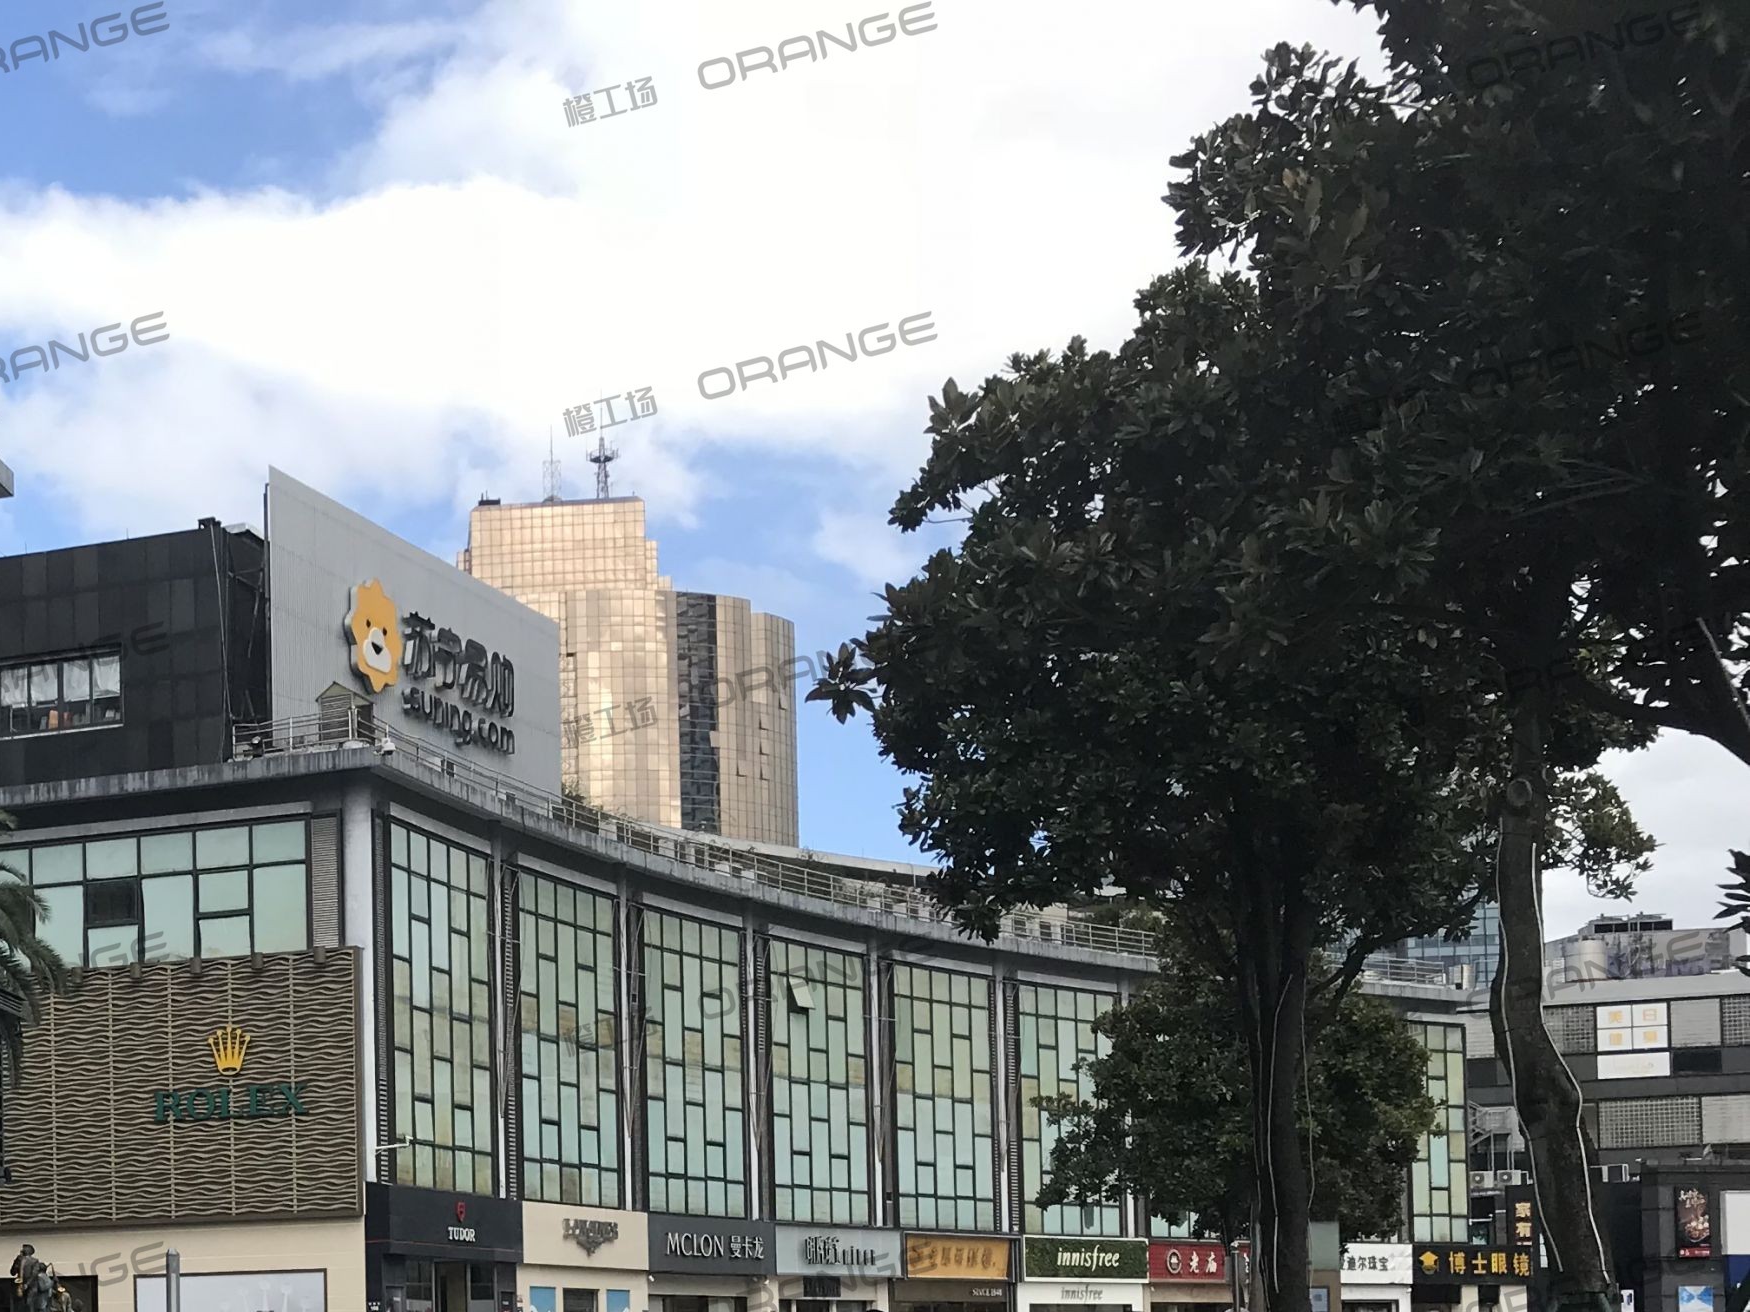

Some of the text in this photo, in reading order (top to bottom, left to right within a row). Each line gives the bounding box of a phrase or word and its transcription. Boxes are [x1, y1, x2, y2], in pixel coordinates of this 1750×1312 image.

[401, 611, 515, 719] 苏宁易购
[401, 687, 516, 756] suning.com
[154, 1083, 308, 1122] ROLEX
[448, 1226, 476, 1242] TUDOR
[666, 1232, 766, 1260] MCLON 曼卡龙
[1056, 1244, 1121, 1273] innisfree
[1448, 1251, 1531, 1277] 博士眼镜
[1060, 1284, 1104, 1304] innisfree
